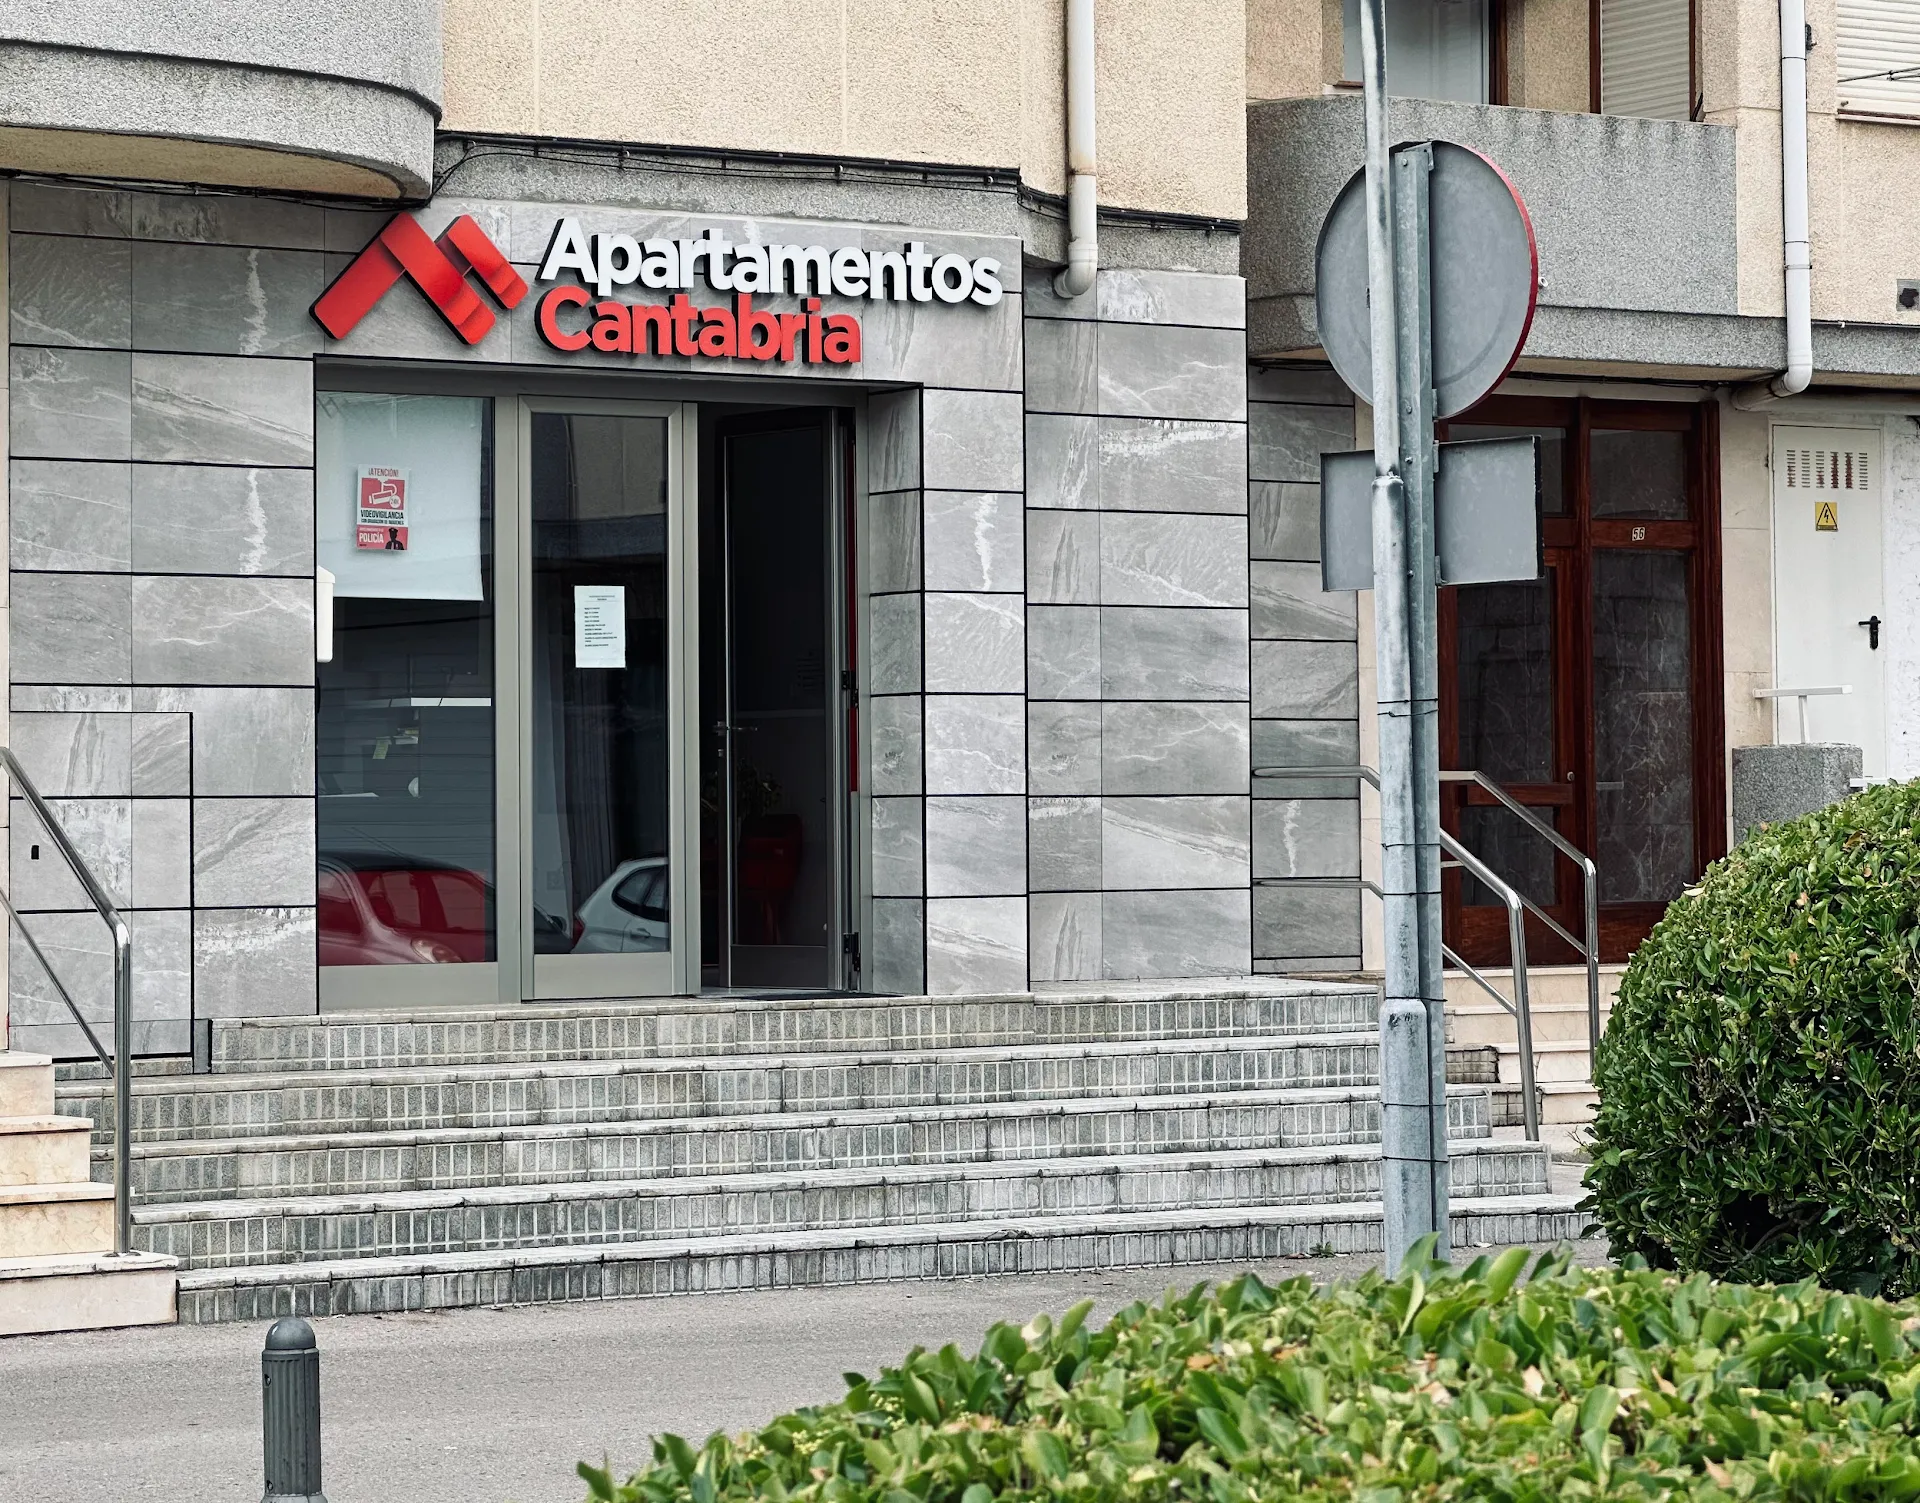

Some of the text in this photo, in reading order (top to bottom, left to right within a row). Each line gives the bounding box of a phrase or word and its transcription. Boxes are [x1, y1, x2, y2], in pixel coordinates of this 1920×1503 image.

[538, 217, 1003, 307] Apartamentos
[536, 284, 862, 364] Cantabria
[361, 510, 404, 519] VIDEOVIGILANCIA
[359, 532, 384, 543] POLICÍA
[1633, 527, 1645, 540] 56
